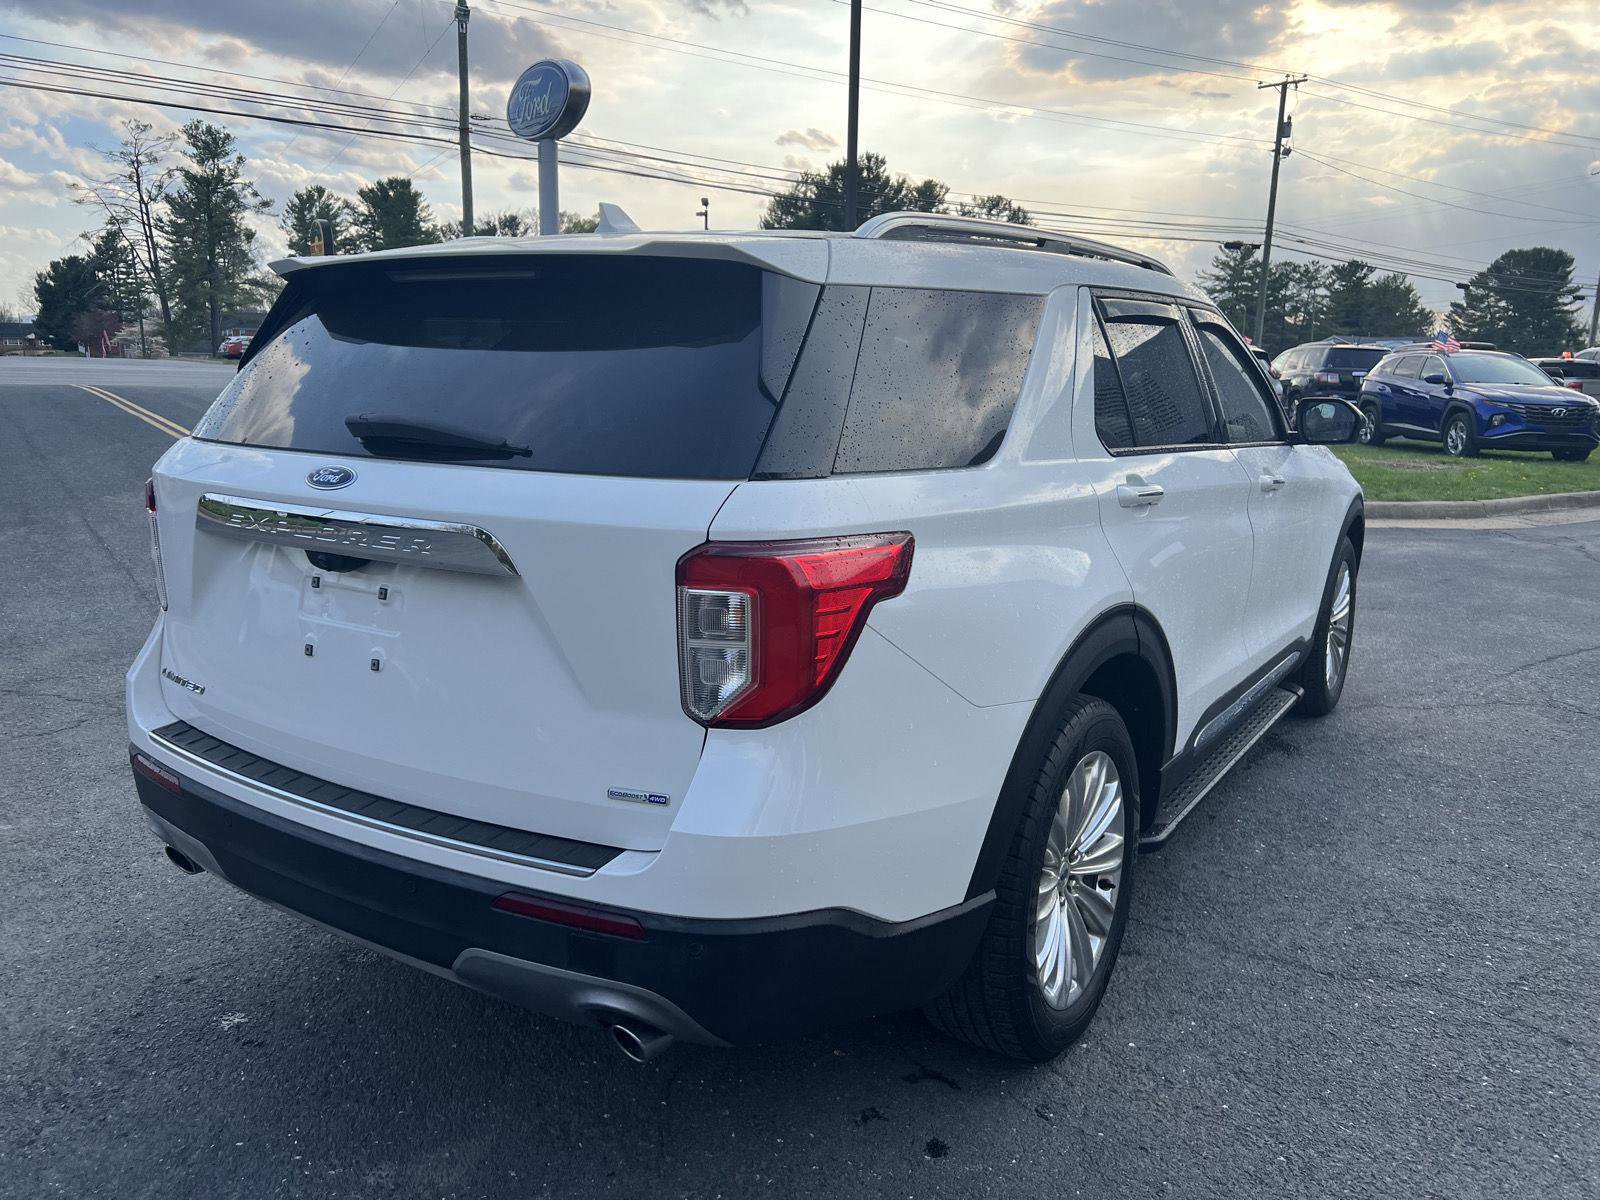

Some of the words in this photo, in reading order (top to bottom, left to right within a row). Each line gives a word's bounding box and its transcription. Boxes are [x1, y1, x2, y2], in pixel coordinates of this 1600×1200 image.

[515, 75, 552, 124] Ford
[313, 468, 344, 483] Ford
[649, 795, 667, 804] 4WD
